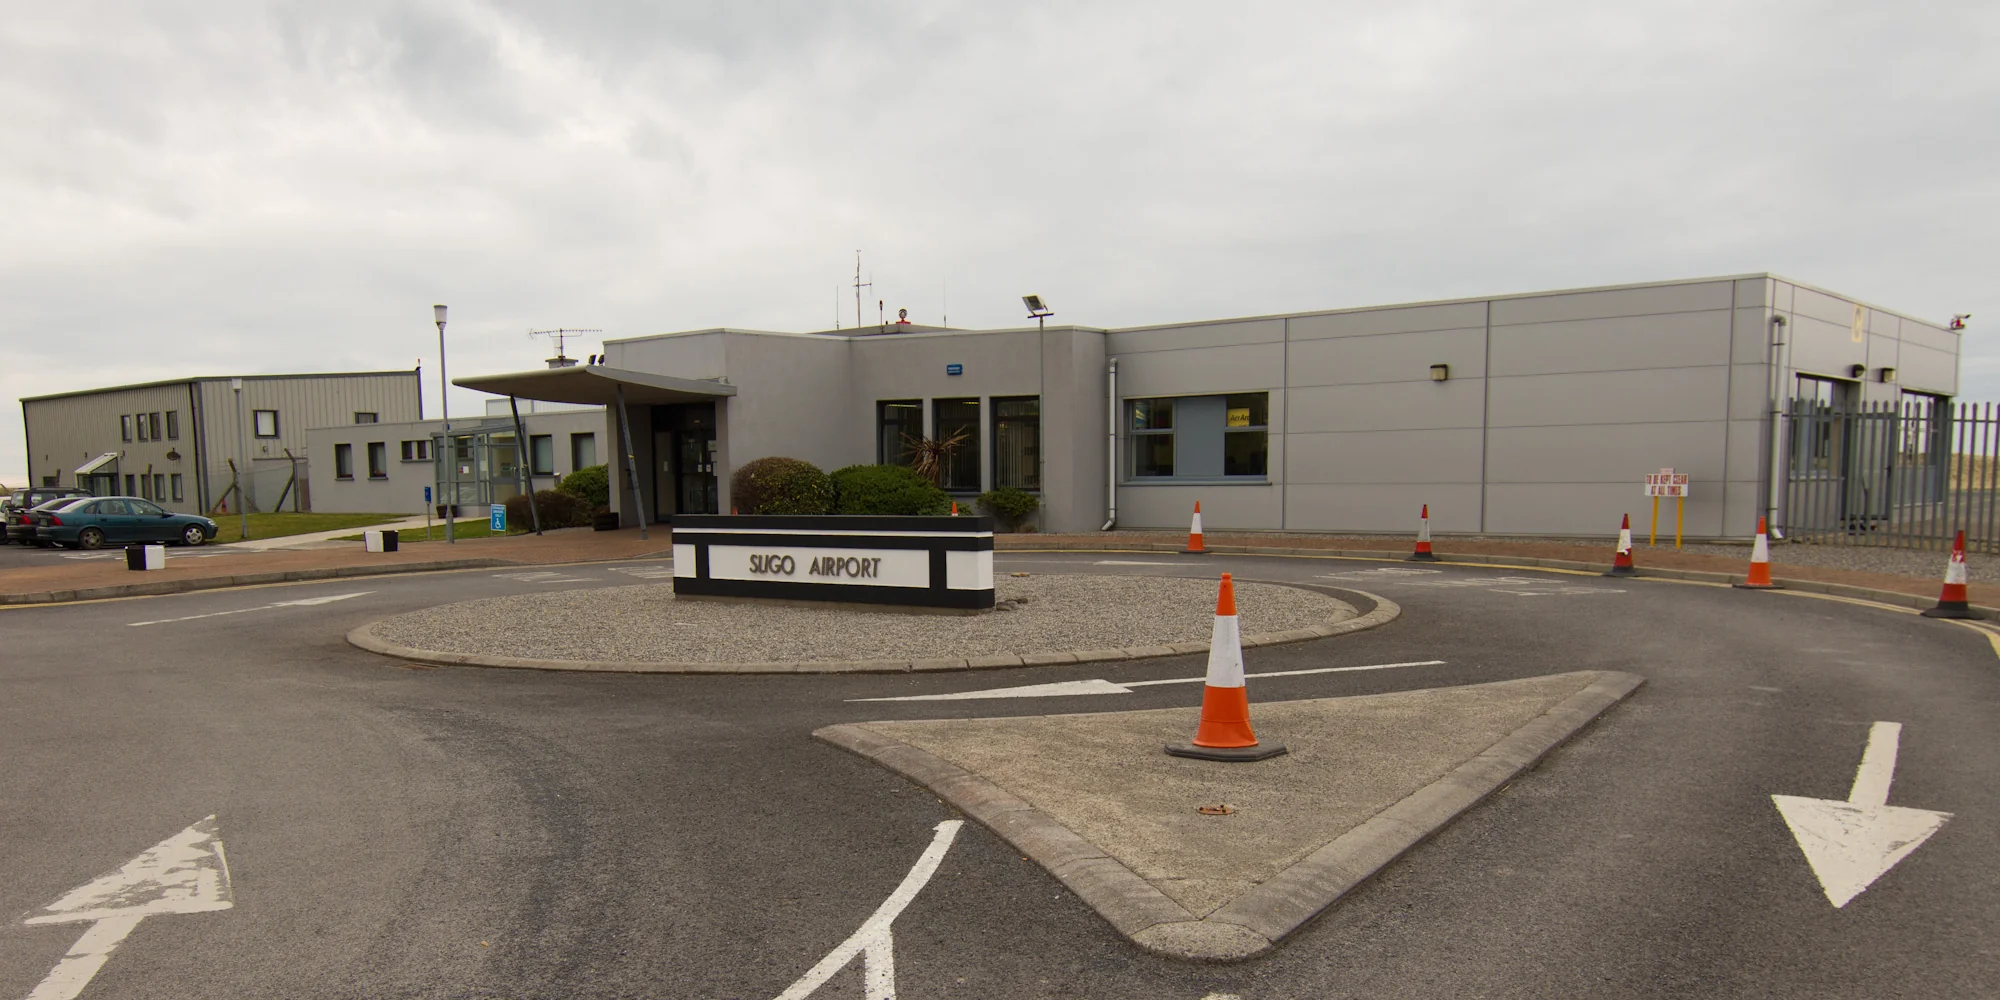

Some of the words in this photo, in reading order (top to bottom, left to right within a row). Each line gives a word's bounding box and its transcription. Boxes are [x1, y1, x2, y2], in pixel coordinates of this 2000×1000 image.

[1646, 475, 1652, 485] TO
[1653, 475, 1659, 485] BE
[1660, 475, 1672, 485] KEPT
[1673, 475, 1687, 485] CLEAR
[1651, 486, 1657, 496] AT
[1658, 486, 1666, 496] ALL
[1667, 486, 1681, 496] TIMES
[749, 554, 796, 576] SLIGO
[809, 556, 882, 578] AIRPORT
